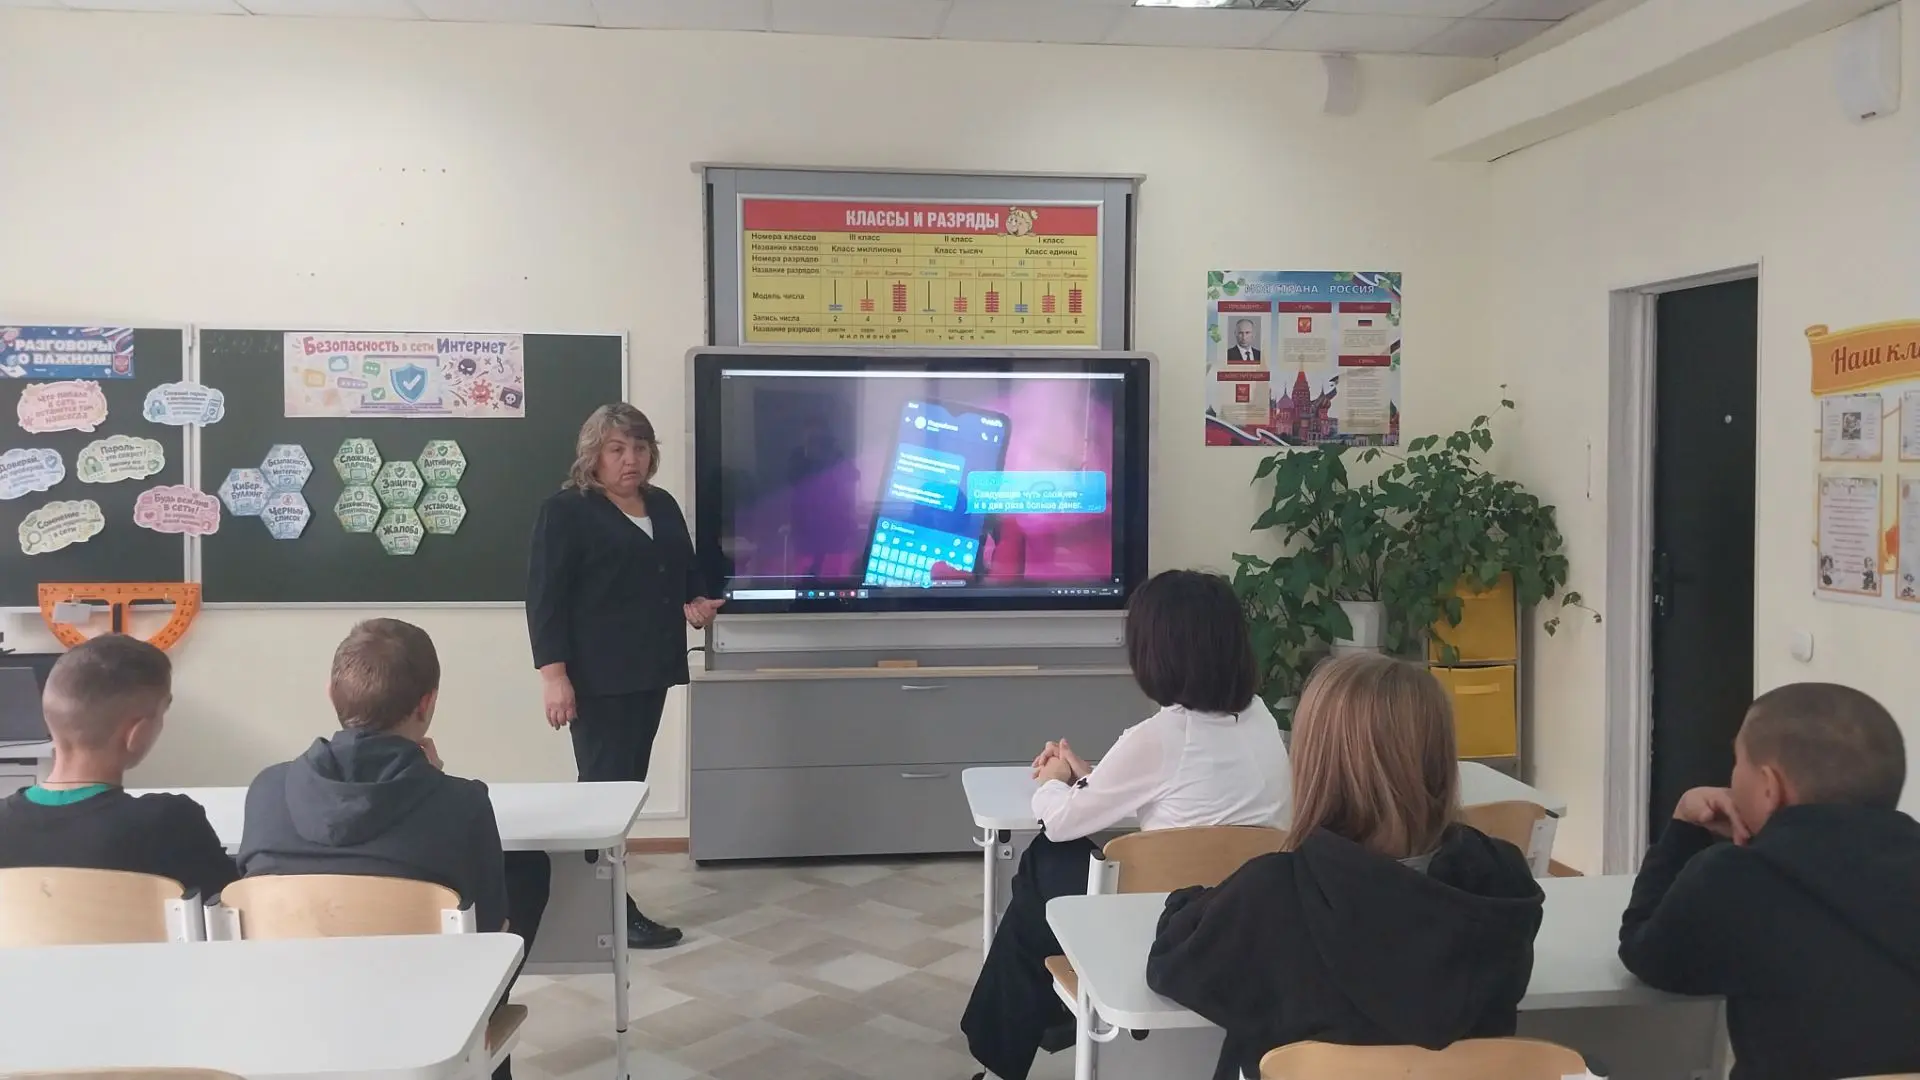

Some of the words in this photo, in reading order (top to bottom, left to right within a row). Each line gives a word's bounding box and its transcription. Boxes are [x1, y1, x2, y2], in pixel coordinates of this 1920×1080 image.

[845, 209, 909, 227] КЛАССЫ
[913, 211, 924, 228] И
[927, 211, 1000, 231] РАЗРЯДЫ
[751, 233, 782, 241] Номера
[831, 245, 855, 253] Класс
[783, 256, 819, 264] разрядов
[751, 266, 785, 274] Название
[1329, 285, 1376, 295] РОССИЯ
[752, 292, 781, 300] Модель
[14, 338, 115, 352] РАЗГОВОРЫ
[303, 336, 399, 355] Безопасность
[436, 337, 507, 354] Интернет
[18, 353, 30, 365] О
[33, 353, 113, 365] ВАЖНОМ!
[1831, 346, 1881, 375] Наш
[1886, 341, 1920, 363] кл
[423, 458, 462, 468] Антивирус
[381, 479, 418, 489] Защита
[154, 493, 176, 504] Будь
[382, 525, 420, 536] Жалоба
